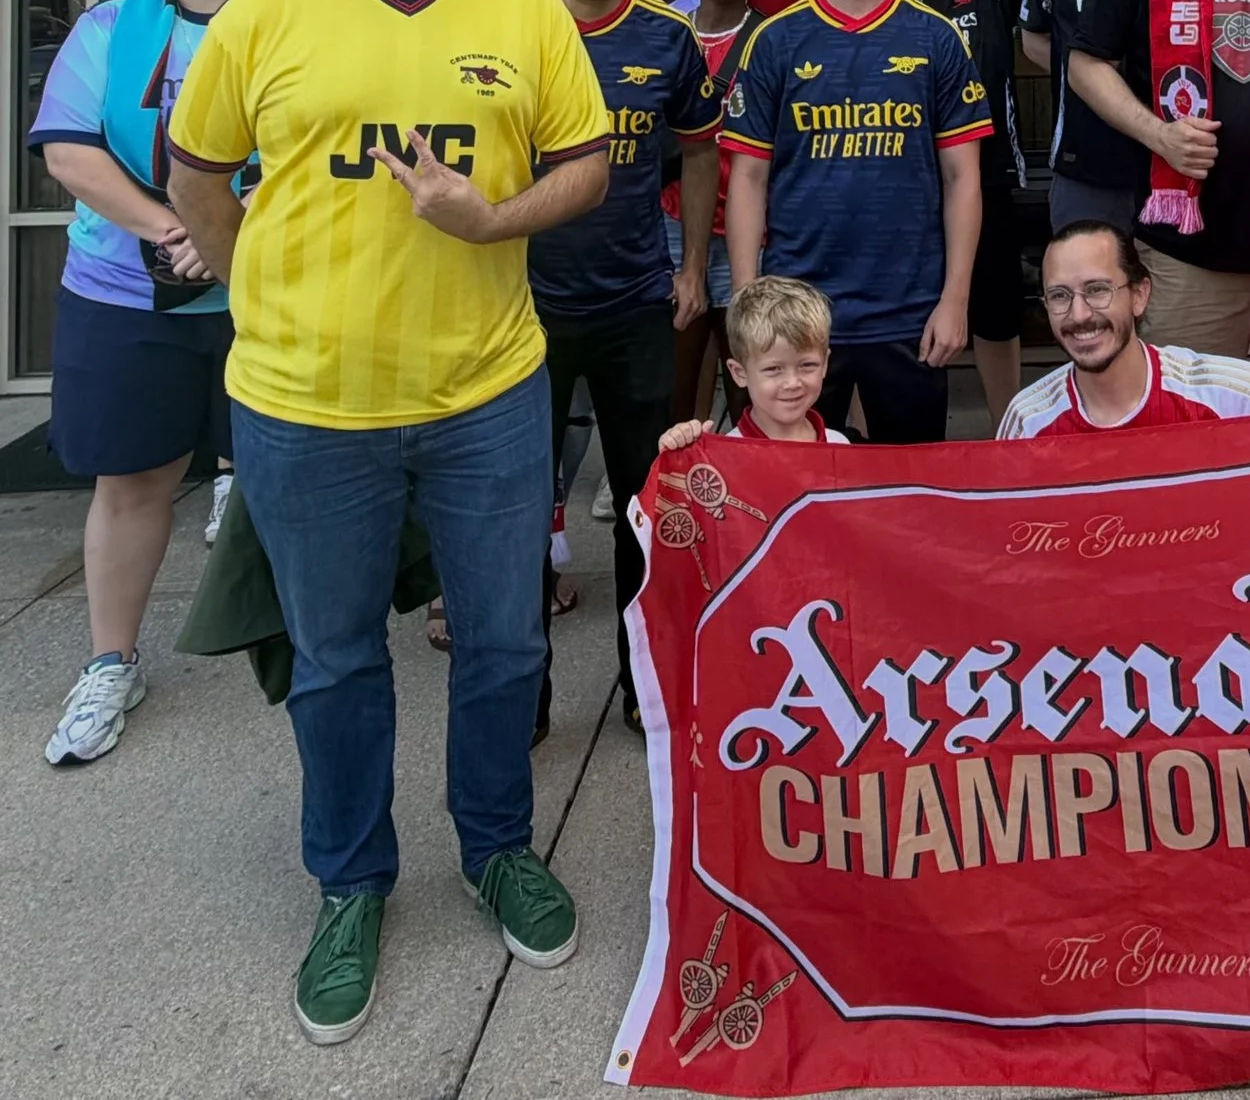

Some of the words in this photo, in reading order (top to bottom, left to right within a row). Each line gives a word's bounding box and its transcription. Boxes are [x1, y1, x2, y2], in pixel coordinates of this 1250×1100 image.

[450, 54, 498, 65] CENTENARY
[500, 58, 518, 74] YEAR
[791, 97, 922, 131] Emirates
[330, 124, 476, 180] JVC
[811, 133, 839, 159] FLY
[842, 132, 905, 158] BETTER
[1005, 520, 1070, 556] The
[1078, 515, 1220, 559] Gunners
[1040, 933, 1109, 986] The
